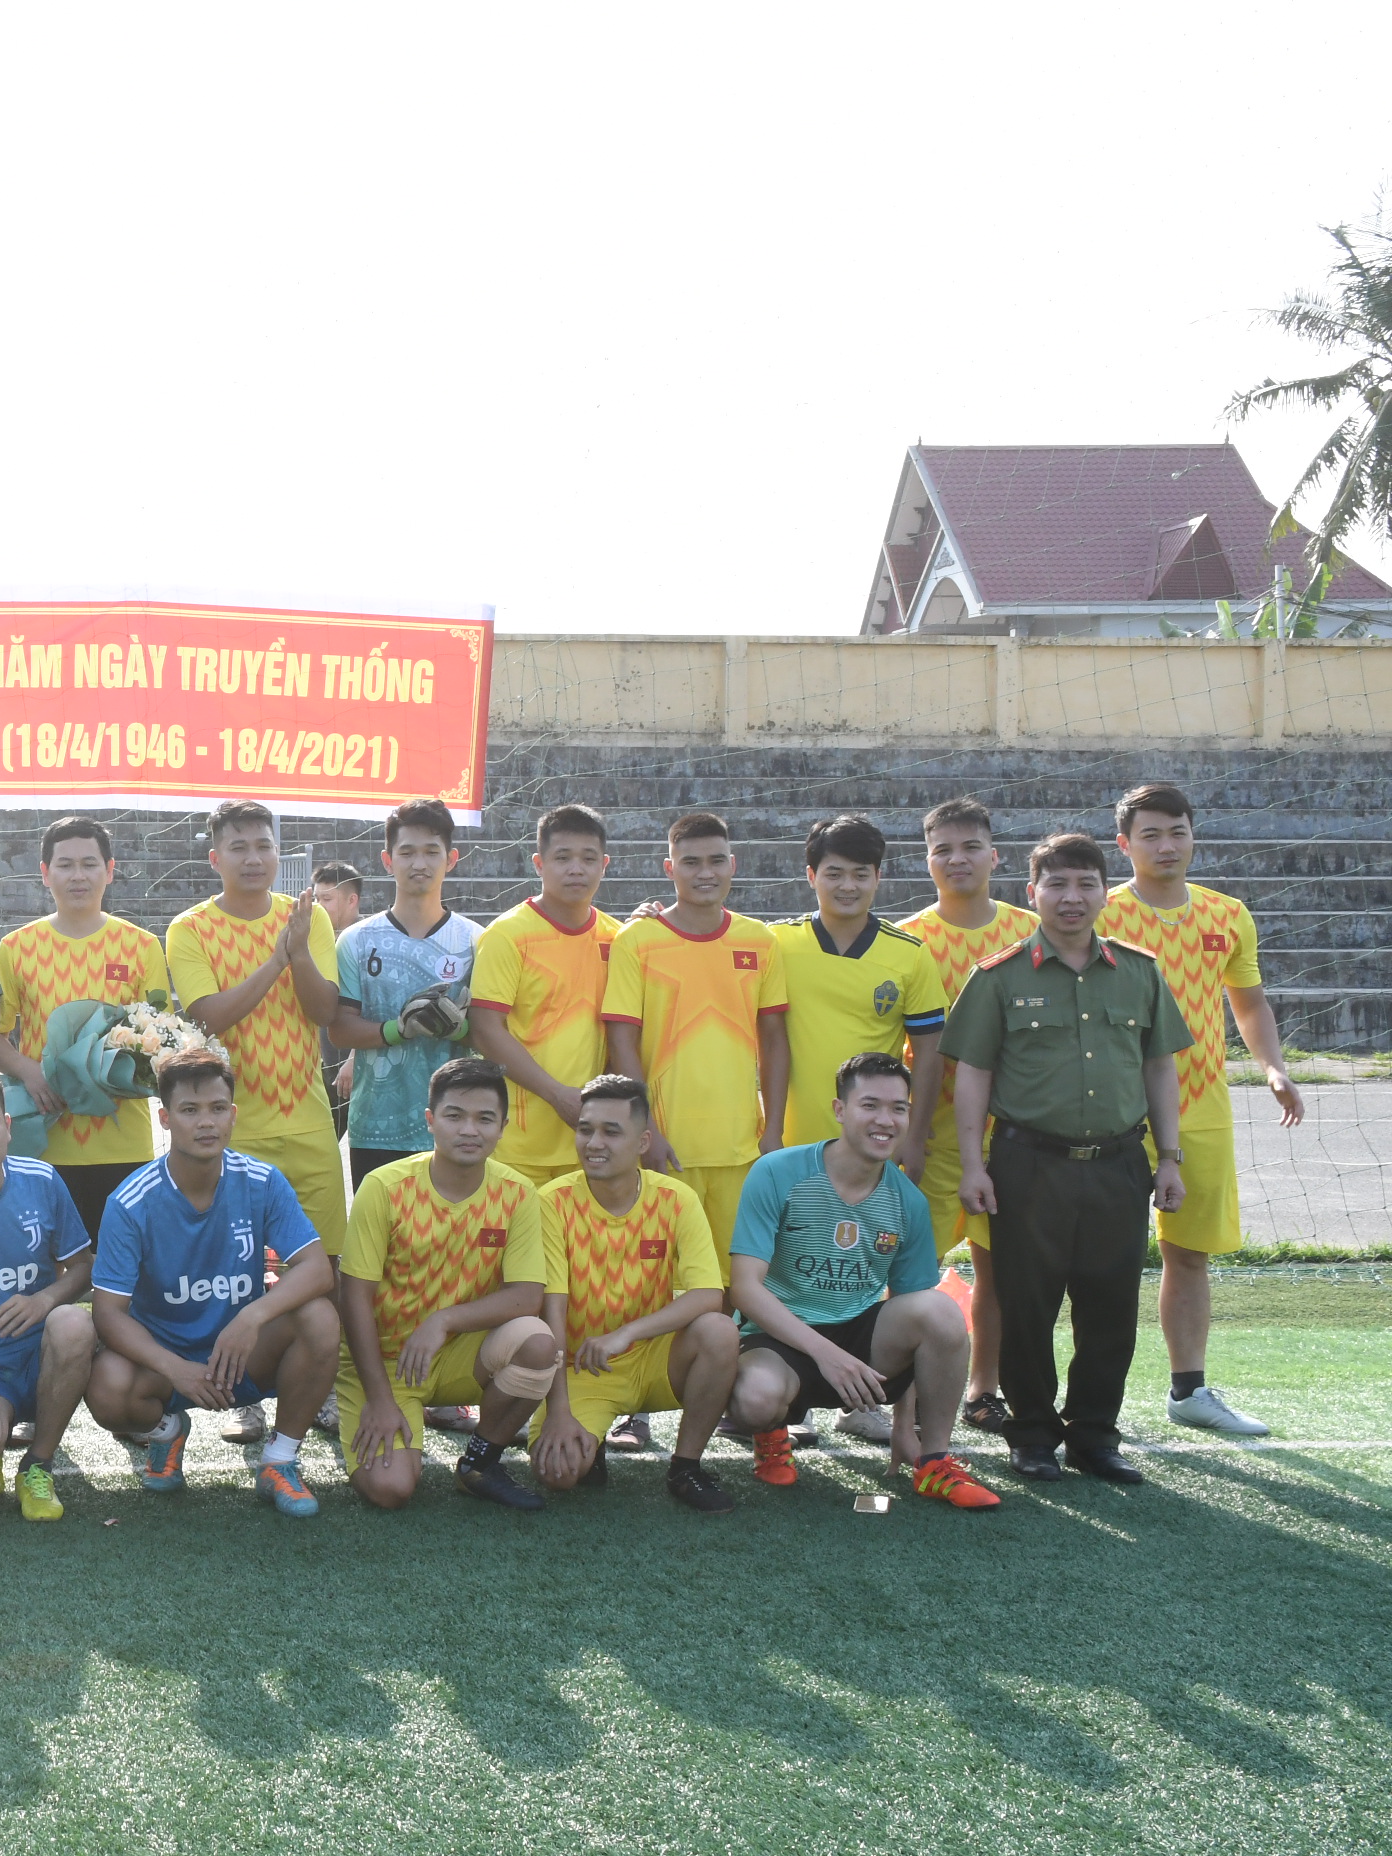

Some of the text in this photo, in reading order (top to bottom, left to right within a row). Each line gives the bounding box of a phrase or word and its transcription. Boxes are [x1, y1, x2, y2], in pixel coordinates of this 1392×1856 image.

[74, 635, 168, 691] NGÀY
[177, 637, 311, 698] TRUYỀN
[322, 641, 435, 705] THỐNG
[3, 722, 186, 773] (18/4/1946
[196, 745, 208, 756] -
[219, 728, 399, 785] 18/4/2021)
[367, 947, 383, 977] 6
[163, 1273, 253, 1306] Jeep
